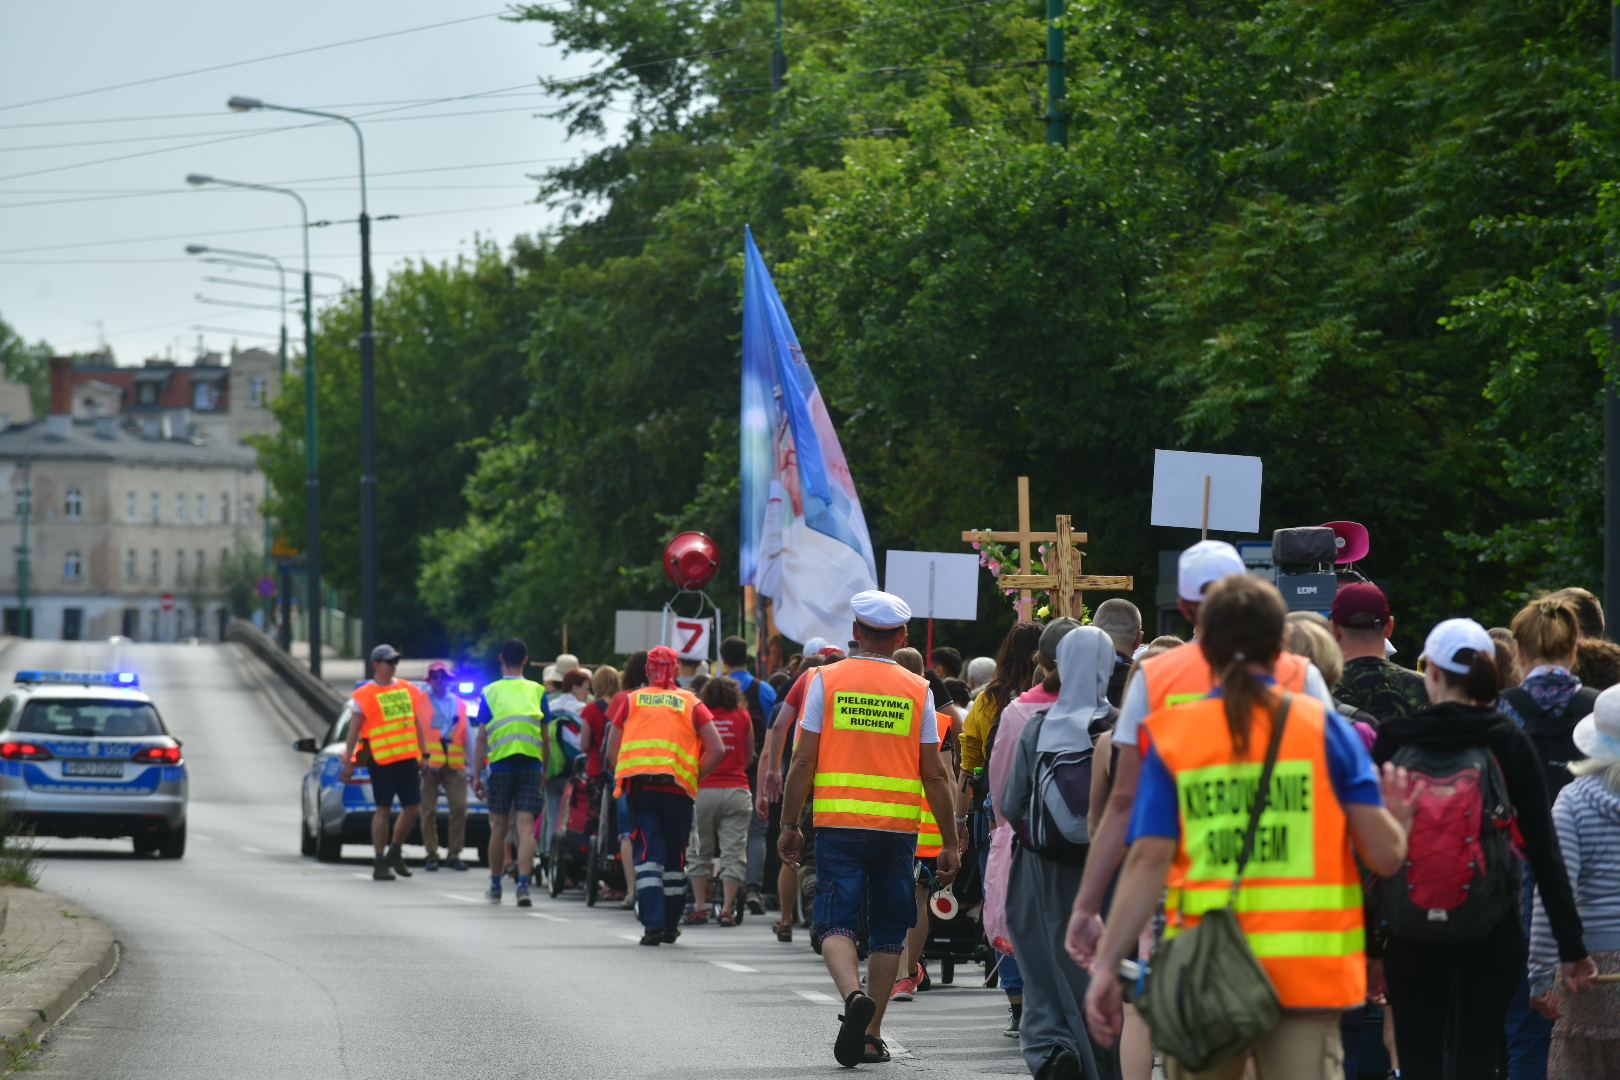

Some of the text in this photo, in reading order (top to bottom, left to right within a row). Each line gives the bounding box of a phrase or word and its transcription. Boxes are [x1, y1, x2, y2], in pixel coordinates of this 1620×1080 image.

[1297, 586, 1318, 595] LDM
[677, 621, 704, 653] 7
[837, 696, 910, 710] PIELGRZYMKA
[840, 706, 905, 720] KIEROWANIE
[850, 717, 895, 729] RUCHEM
